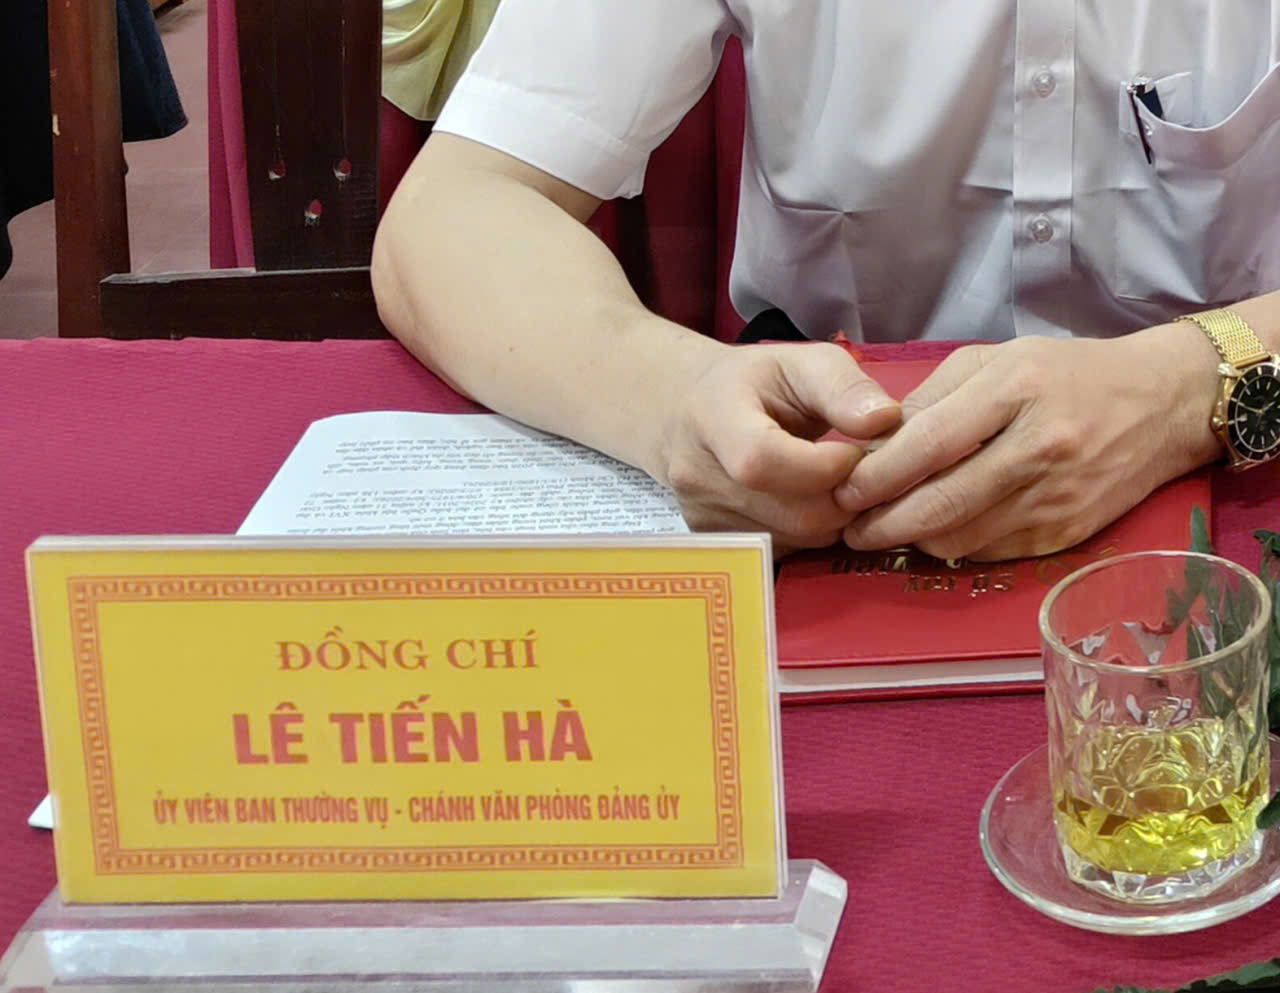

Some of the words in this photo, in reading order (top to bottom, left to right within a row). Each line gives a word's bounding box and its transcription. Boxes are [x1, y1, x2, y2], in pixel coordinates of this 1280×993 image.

[277, 624, 428, 671] ĐỒNG
[446, 629, 539, 670] CHÍ
[232, 701, 309, 765] LÊ
[328, 694, 481, 764] TIẾN
[502, 698, 593, 763] HÀ
[152, 790, 178, 824] ỦY
[184, 793, 230, 825] VIÊN
[234, 796, 277, 824] BAN
[280, 791, 360, 824] THƯỜNG
[363, 797, 389, 829] VỤ
[408, 791, 476, 823] CHÁNH
[481, 790, 521, 822] VĂN
[525, 788, 593, 822] PHÒNG
[597, 785, 652, 822] ĐẢNG
[656, 785, 681, 822] ỦY
